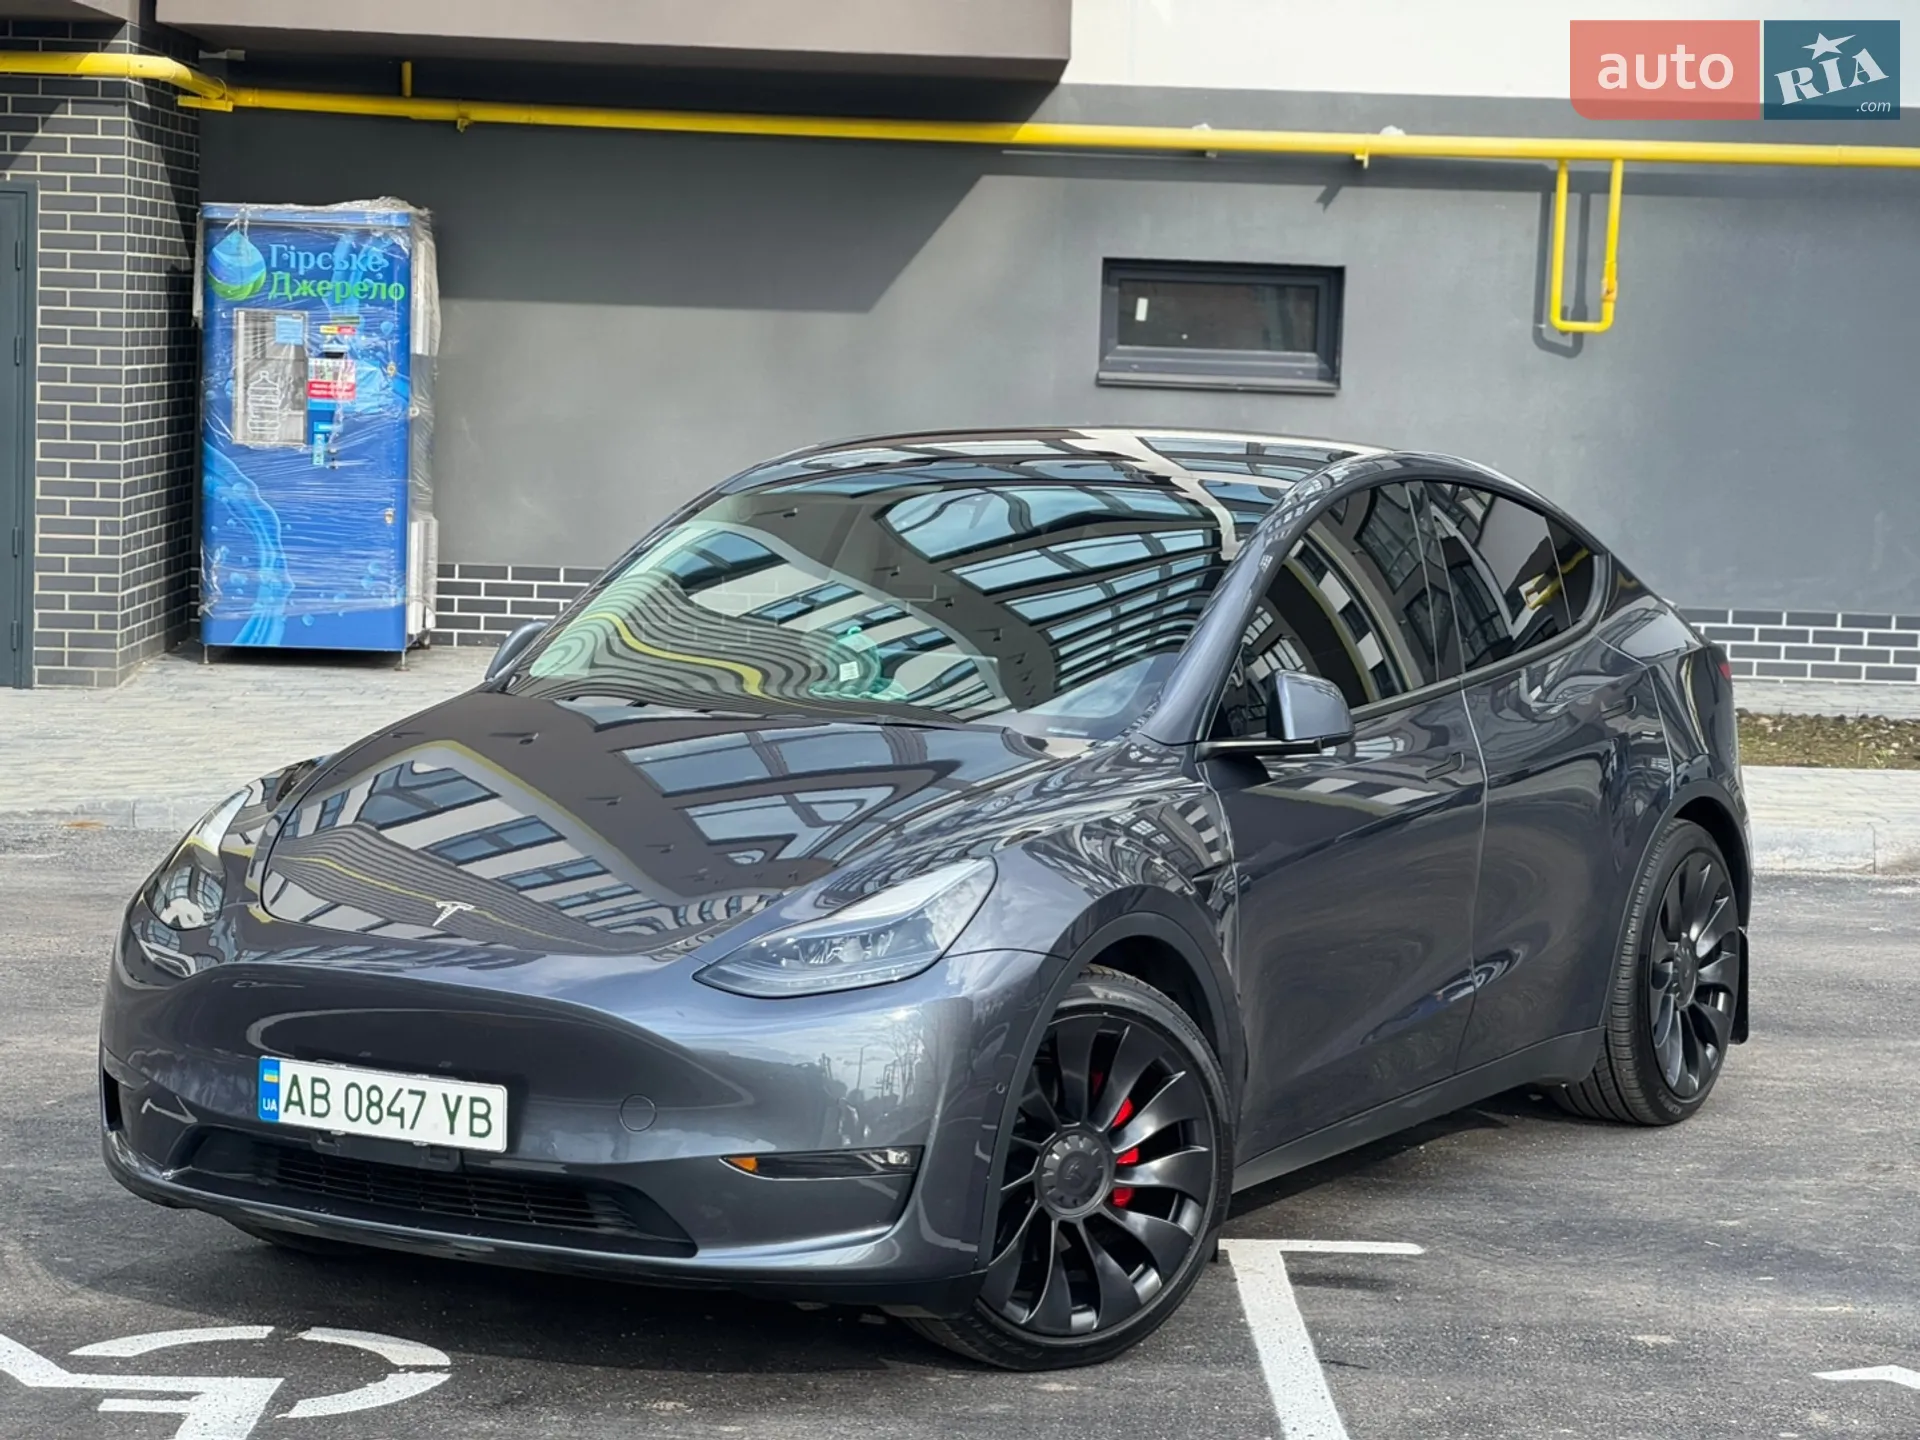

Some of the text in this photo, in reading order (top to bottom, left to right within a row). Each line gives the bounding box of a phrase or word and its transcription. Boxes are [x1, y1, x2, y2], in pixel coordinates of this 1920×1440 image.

[269, 243, 385, 275] Гірське
[268, 271, 405, 303] Джерело
[262, 1098, 278, 1113] UA
[283, 1074, 493, 1139] AB 0847 YB
